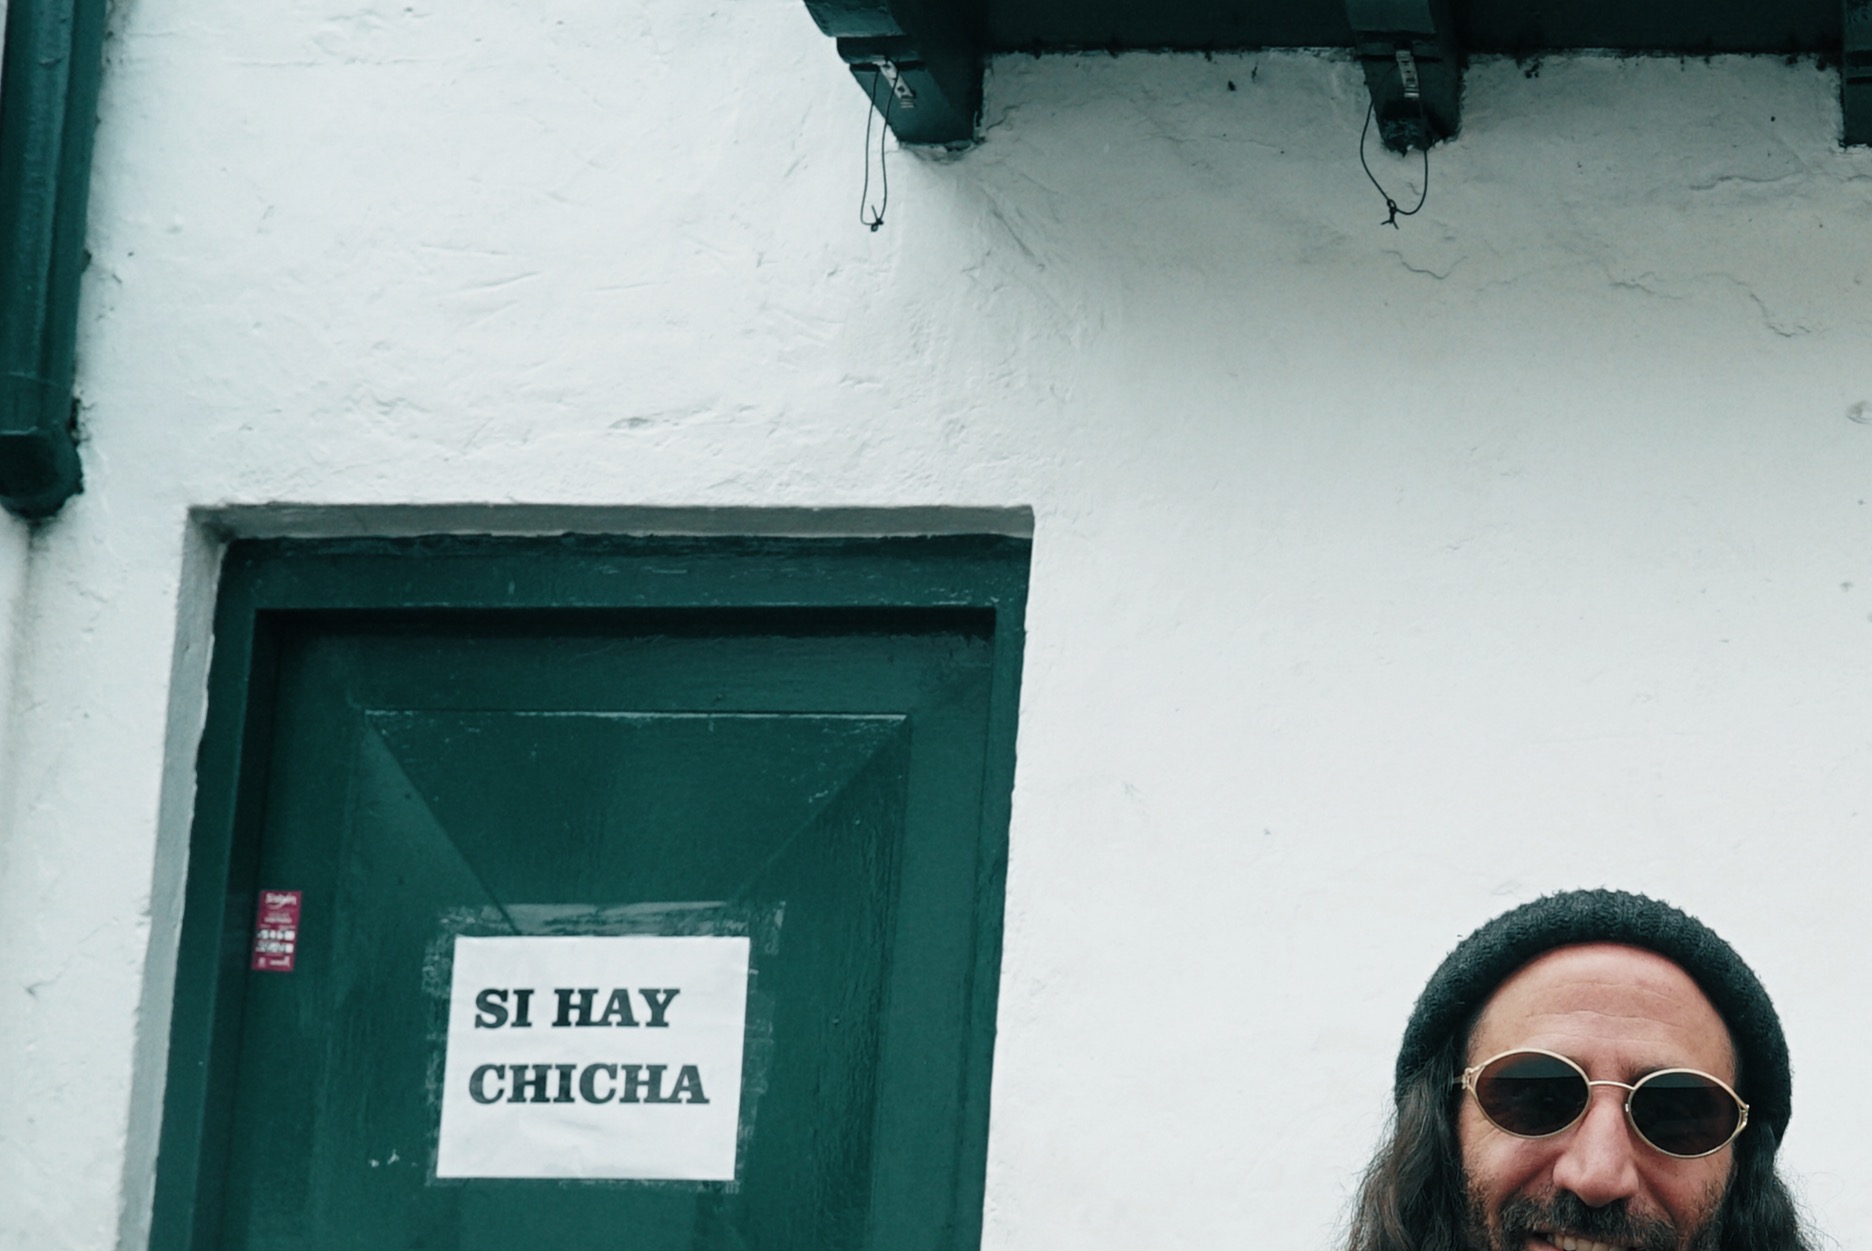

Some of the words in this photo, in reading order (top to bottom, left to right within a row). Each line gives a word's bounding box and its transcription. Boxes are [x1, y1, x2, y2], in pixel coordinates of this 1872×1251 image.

[475, 988, 535, 1029] SI
[552, 988, 680, 1028] HAY
[468, 1063, 709, 1105] CHICHA
